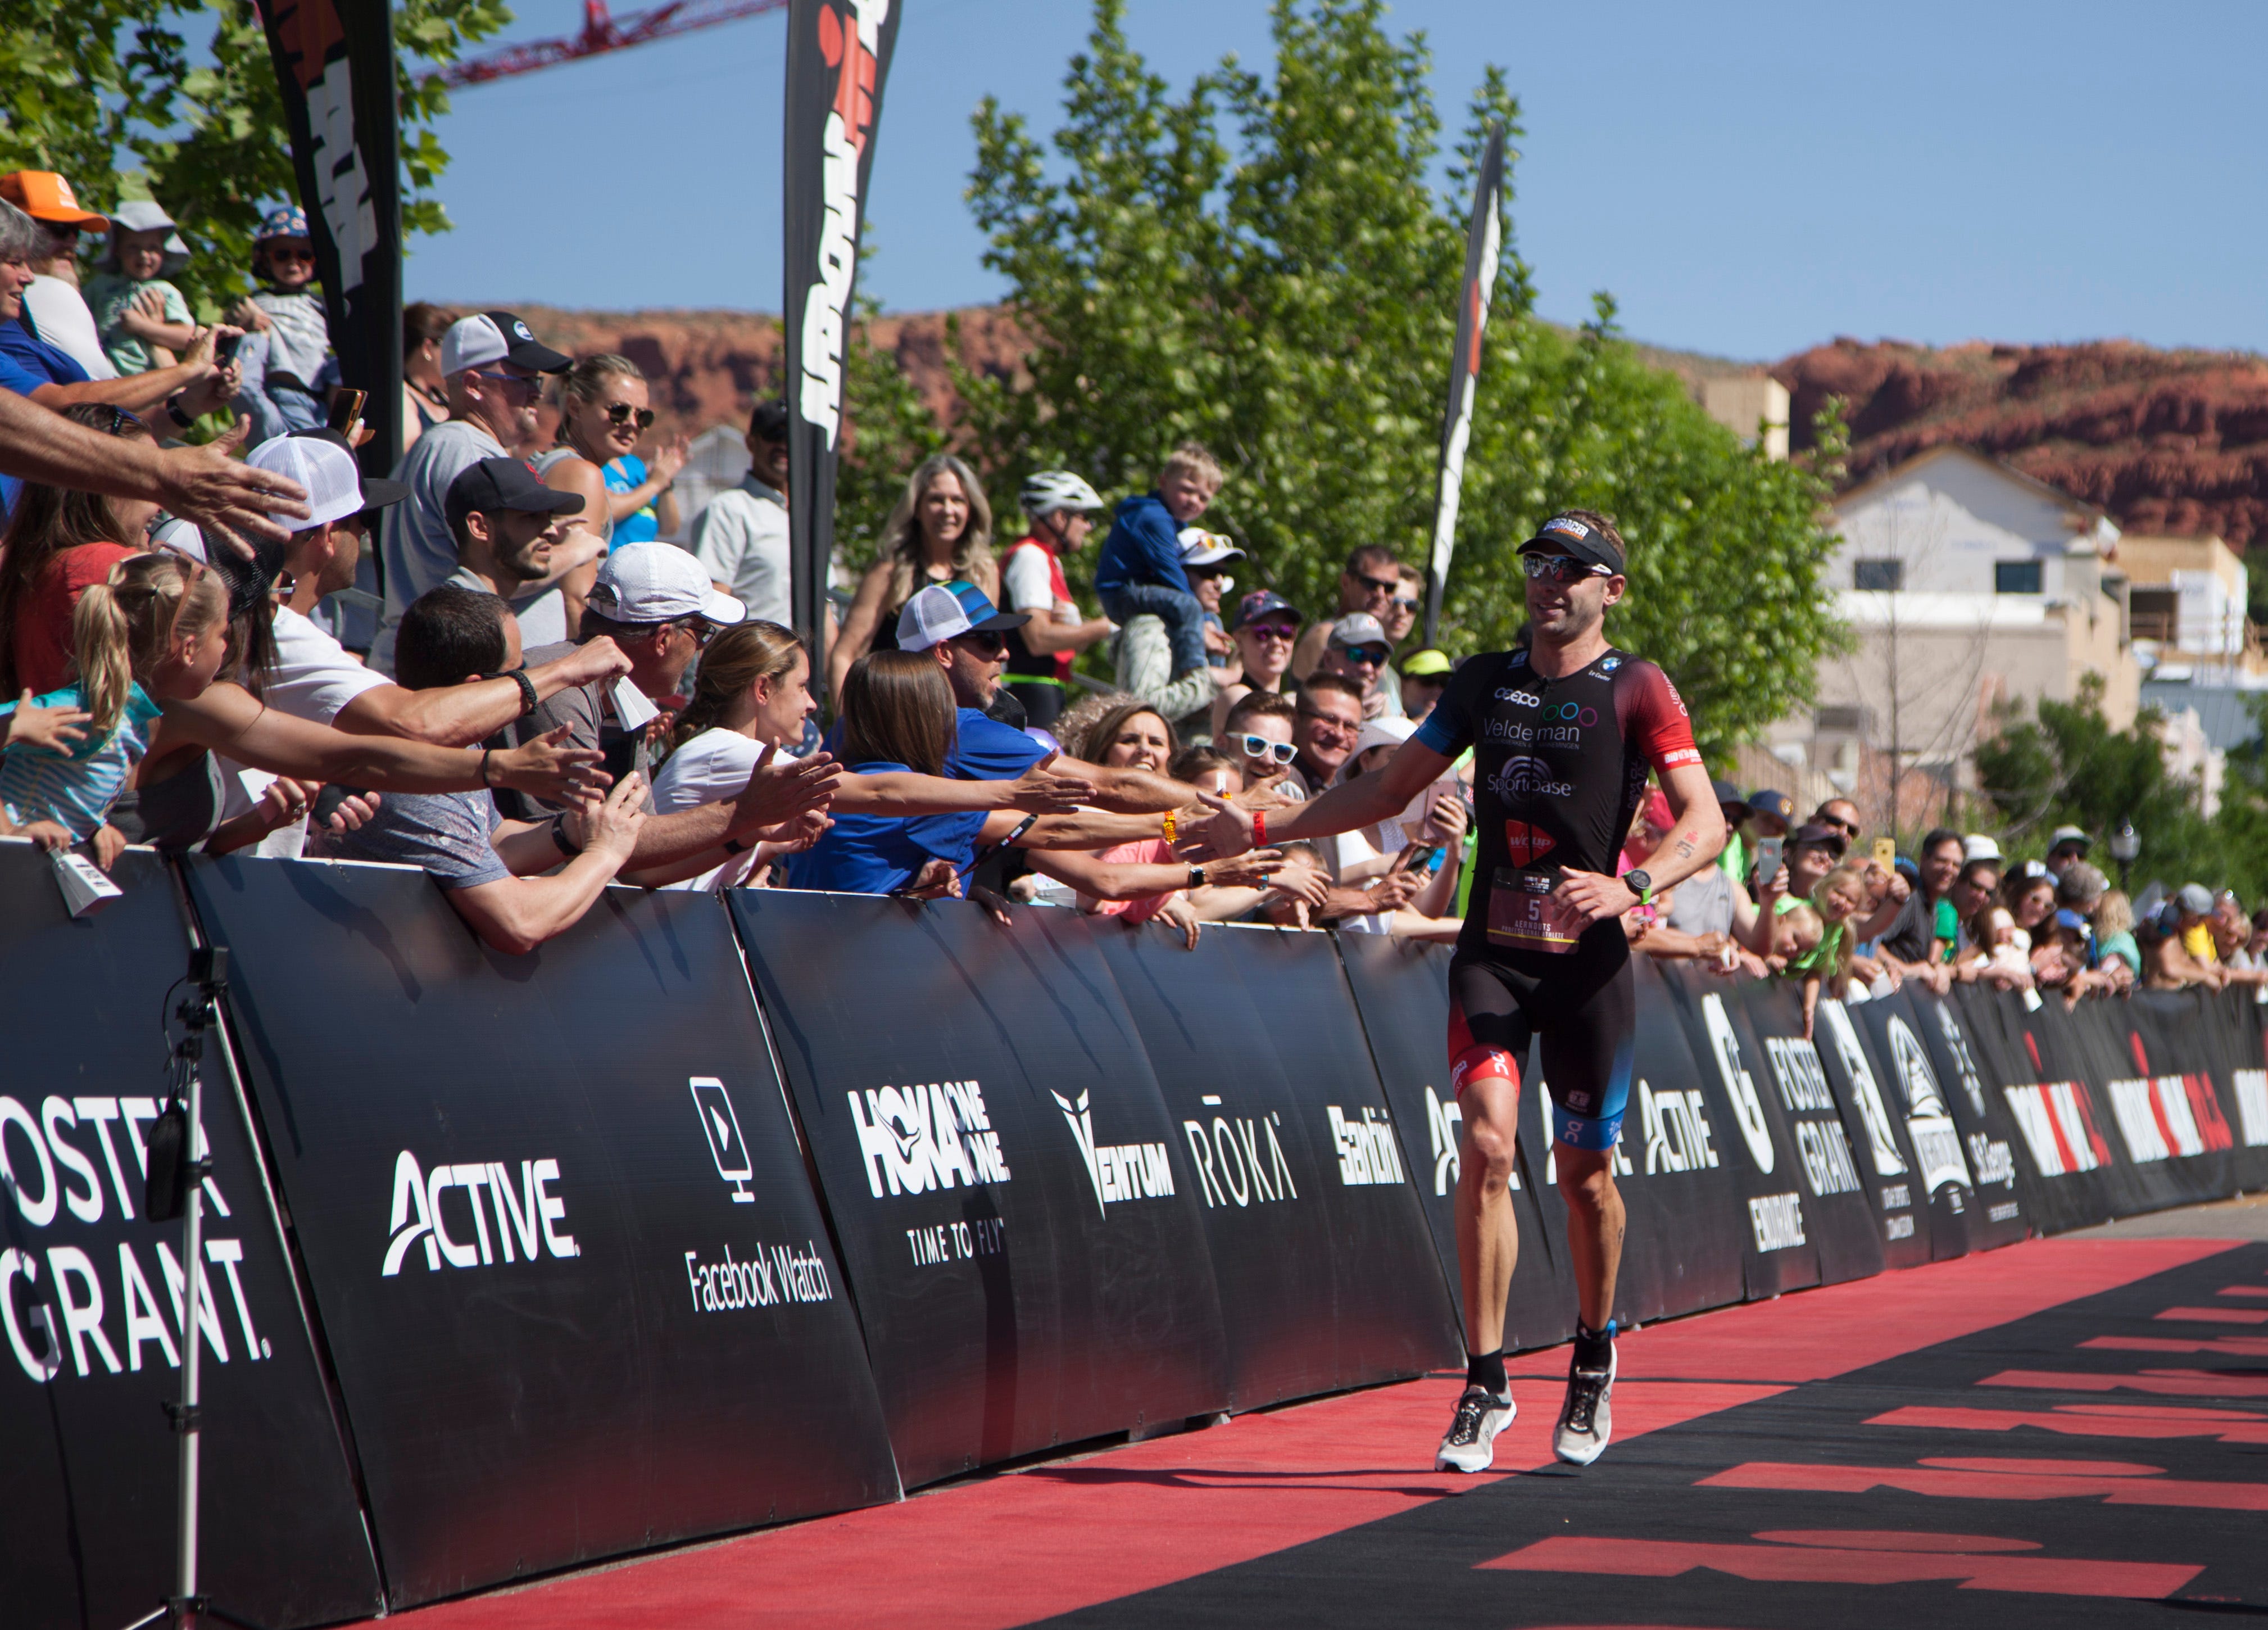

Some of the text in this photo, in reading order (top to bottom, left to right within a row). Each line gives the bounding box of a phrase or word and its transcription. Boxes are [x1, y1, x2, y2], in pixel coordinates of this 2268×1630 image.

[1501, 925, 1564, 939] PROFESSIONAL ATHLETE
[1514, 920, 1552, 932] AERNOUTS
[1527, 899, 1541, 921] 5
[944, 1080, 991, 1133] ONE
[1638, 1078, 1720, 1175] ACTIVE
[963, 1131, 1008, 1185] ONE
[1050, 1088, 1175, 1222] VENTUM
[1326, 1105, 1405, 1185] Santini
[1794, 1120, 1861, 1197] GRANT
[382, 1150, 574, 1276] ACTIVE
[906, 1219, 1000, 1266] TIME TO FLY
[0, 1239, 261, 1383] GRANT
[684, 1239, 833, 1312] Facebook Watch
